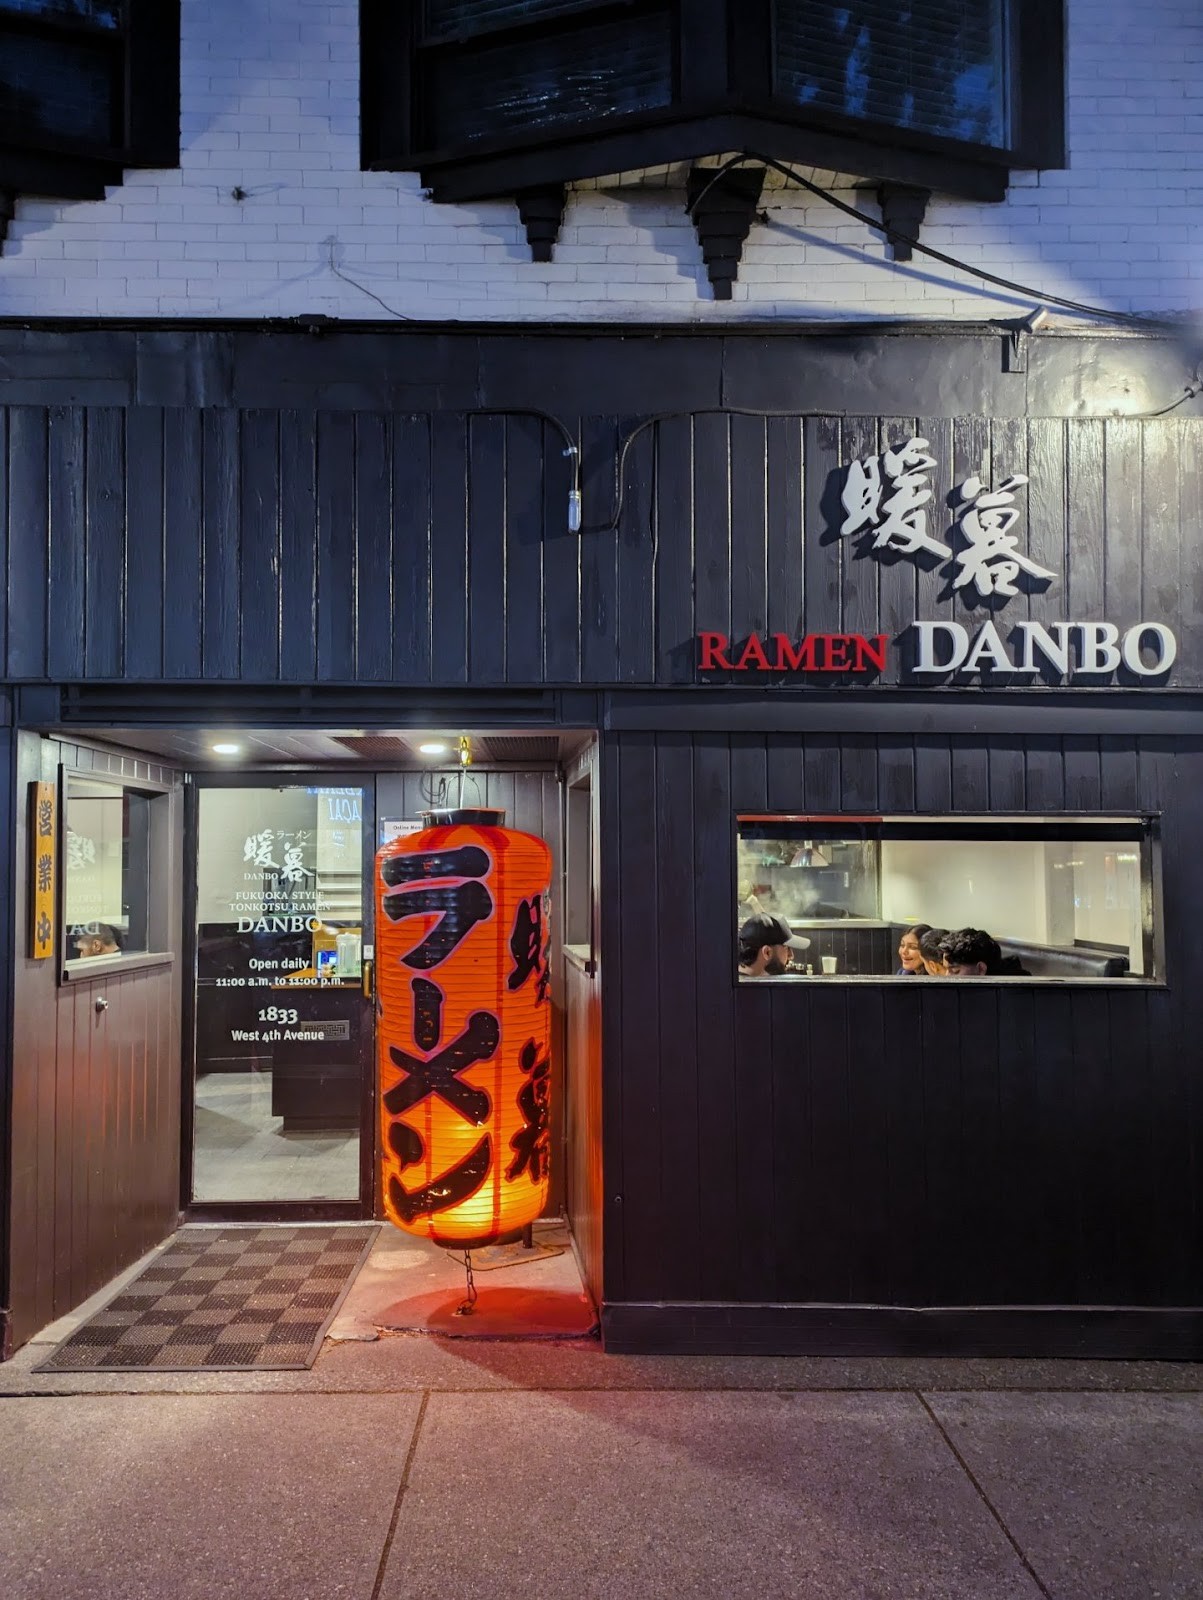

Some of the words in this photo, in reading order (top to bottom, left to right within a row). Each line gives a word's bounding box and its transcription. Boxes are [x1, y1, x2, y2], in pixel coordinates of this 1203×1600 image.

[699, 631, 890, 673] RAMEN
[912, 619, 1178, 677] DANBO
[276, 830, 312, 840] ラーメン
[236, 892, 289, 900] FUKUOKA
[292, 892, 325, 900] STYLE
[229, 903, 289, 911] TONKOTSU
[292, 903, 331, 911] RAMEN
[237, 916, 323, 933] DANBO
[249, 958, 279, 971] Open
[281, 958, 309, 971] daily
[216, 978, 245, 986] 11:00
[248, 978, 272, 986] a.m.
[275, 977, 286, 985] to
[289, 977, 318, 986] 11:00
[321, 978, 345, 988] p.m.
[258, 1006, 298, 1024] 1833
[231, 1030, 260, 1041] West
[262, 1030, 281, 1042] 4th
[284, 1030, 325, 1041] Avenue
[381, 845, 500, 1223] ラーメン
